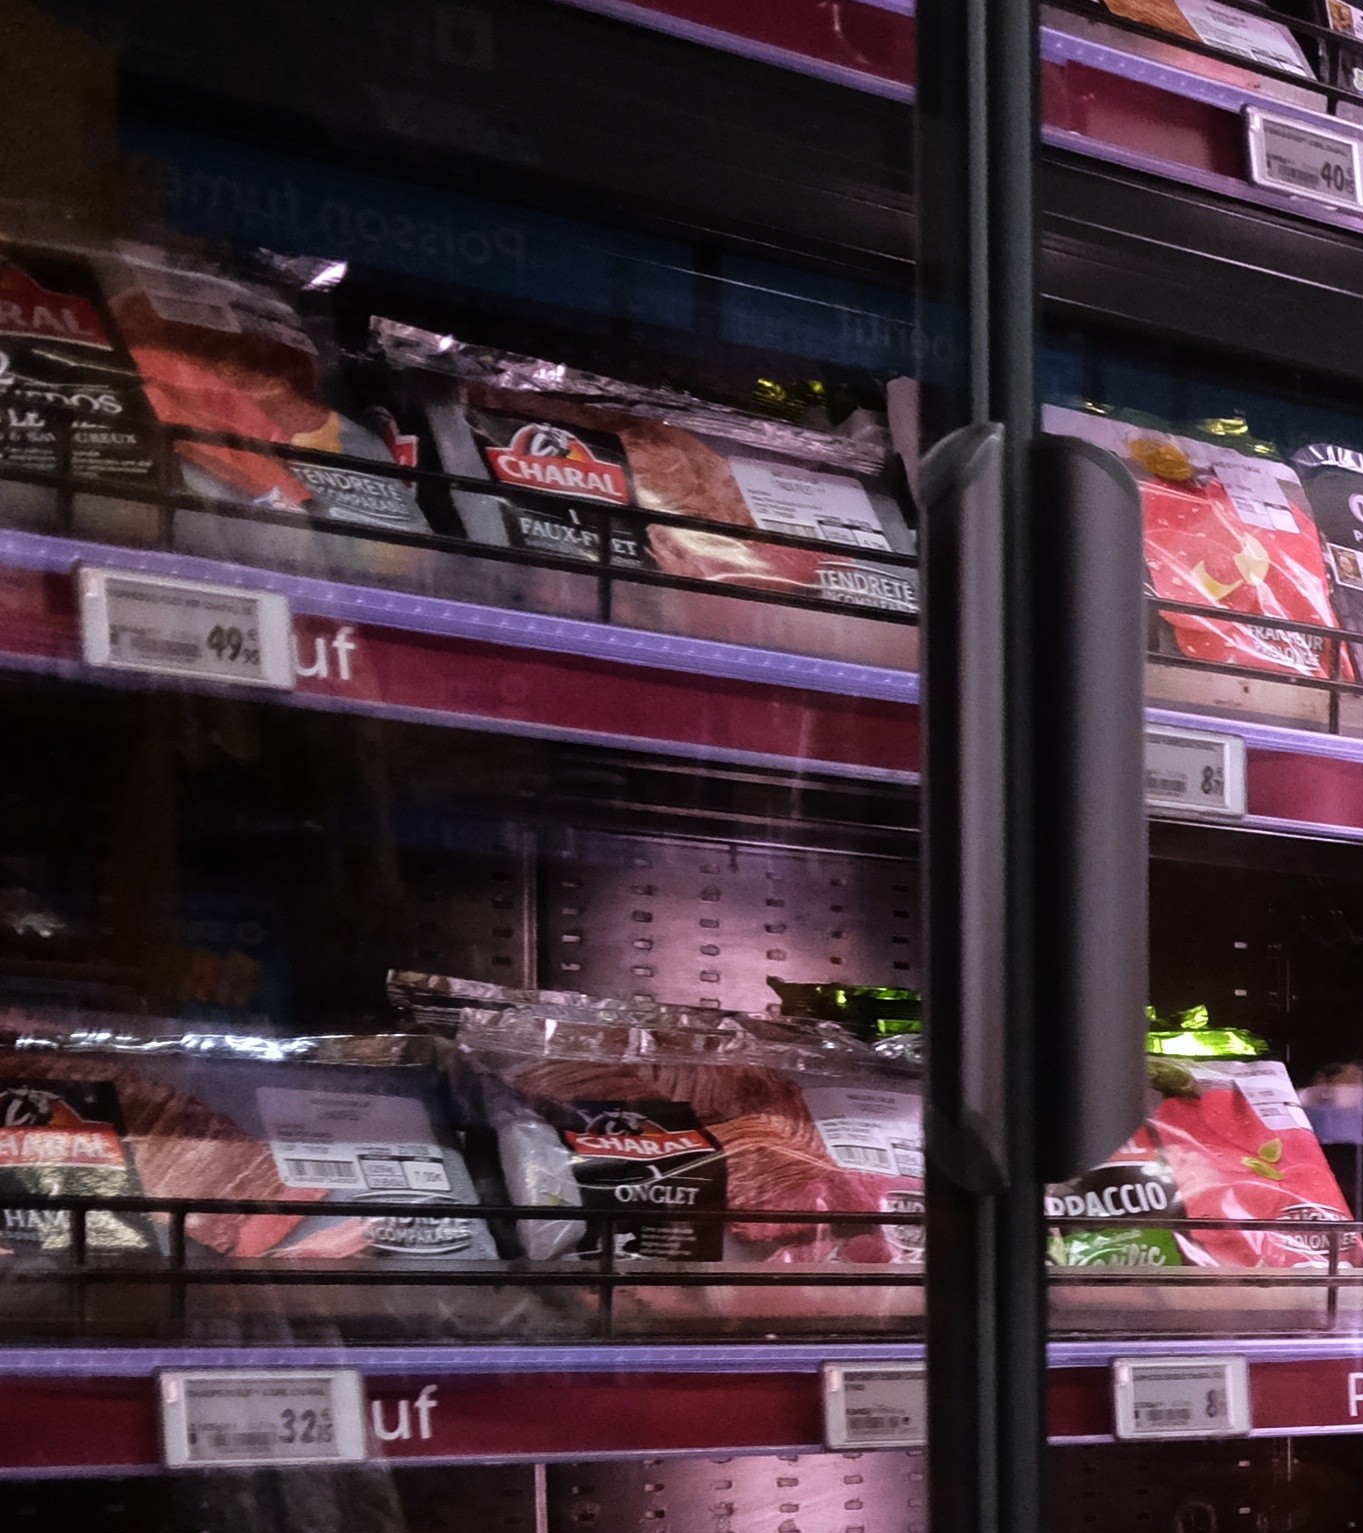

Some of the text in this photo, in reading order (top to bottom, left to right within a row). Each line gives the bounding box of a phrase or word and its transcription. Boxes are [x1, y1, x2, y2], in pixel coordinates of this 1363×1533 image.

[1320, 161, 1345, 192] 40
[499, 453, 624, 499] CHARAL
[568, 508, 582, 526] 1
[520, 517, 638, 558] FAUX-FIET
[814, 568, 918, 602] TENDRETÉ
[205, 625, 243, 662] 49
[295, 625, 356, 681] uf
[1201, 765, 1214, 795] 8
[576, 1135, 704, 1156] CHARAL
[614, 1184, 699, 1206] ONGLET
[278, 1408, 318, 1445] 32
[371, 1383, 438, 1441] uf
